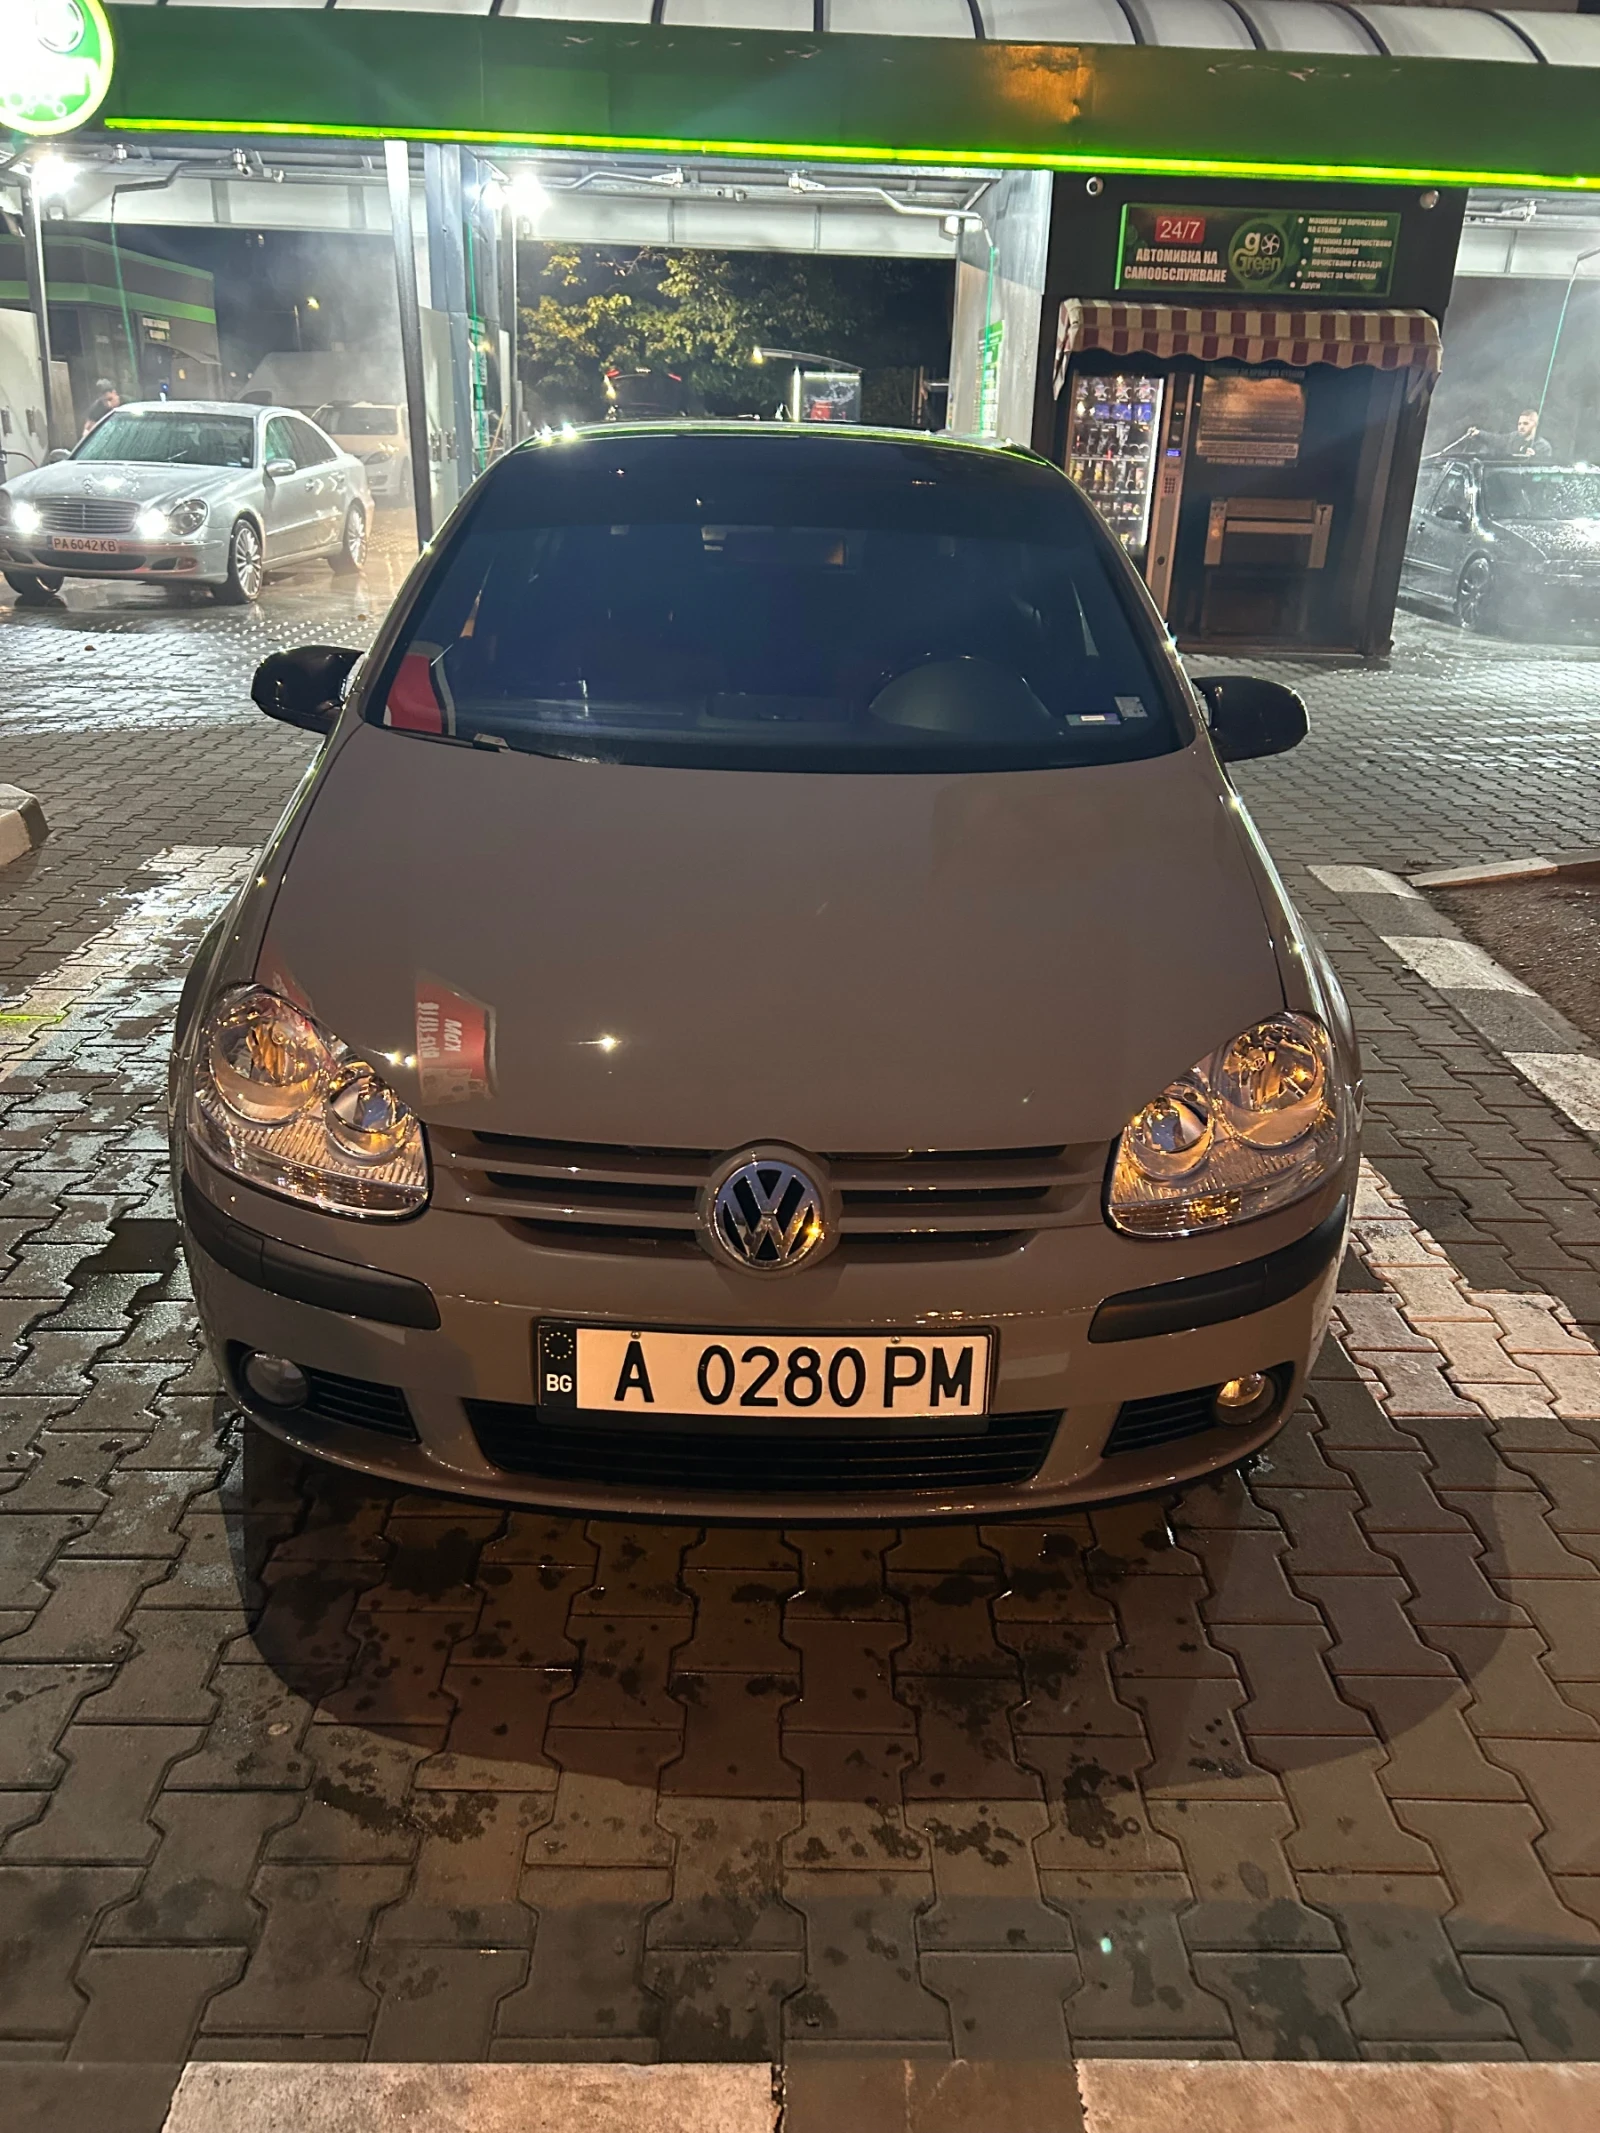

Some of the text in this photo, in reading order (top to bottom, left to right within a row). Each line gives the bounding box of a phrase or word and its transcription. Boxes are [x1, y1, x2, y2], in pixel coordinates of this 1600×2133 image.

[1160, 220, 1201, 239] 24/7
[1135, 248, 1218, 264] АВТОМИВКА НА
[1232, 248, 1282, 272] Green
[1124, 265, 1228, 283] САМООБСЛУЖВАНЕ
[70, 539, 98, 551] 6042
[546, 1373, 573, 1393] BG
[614, 1340, 974, 1408] A 0280 PM
